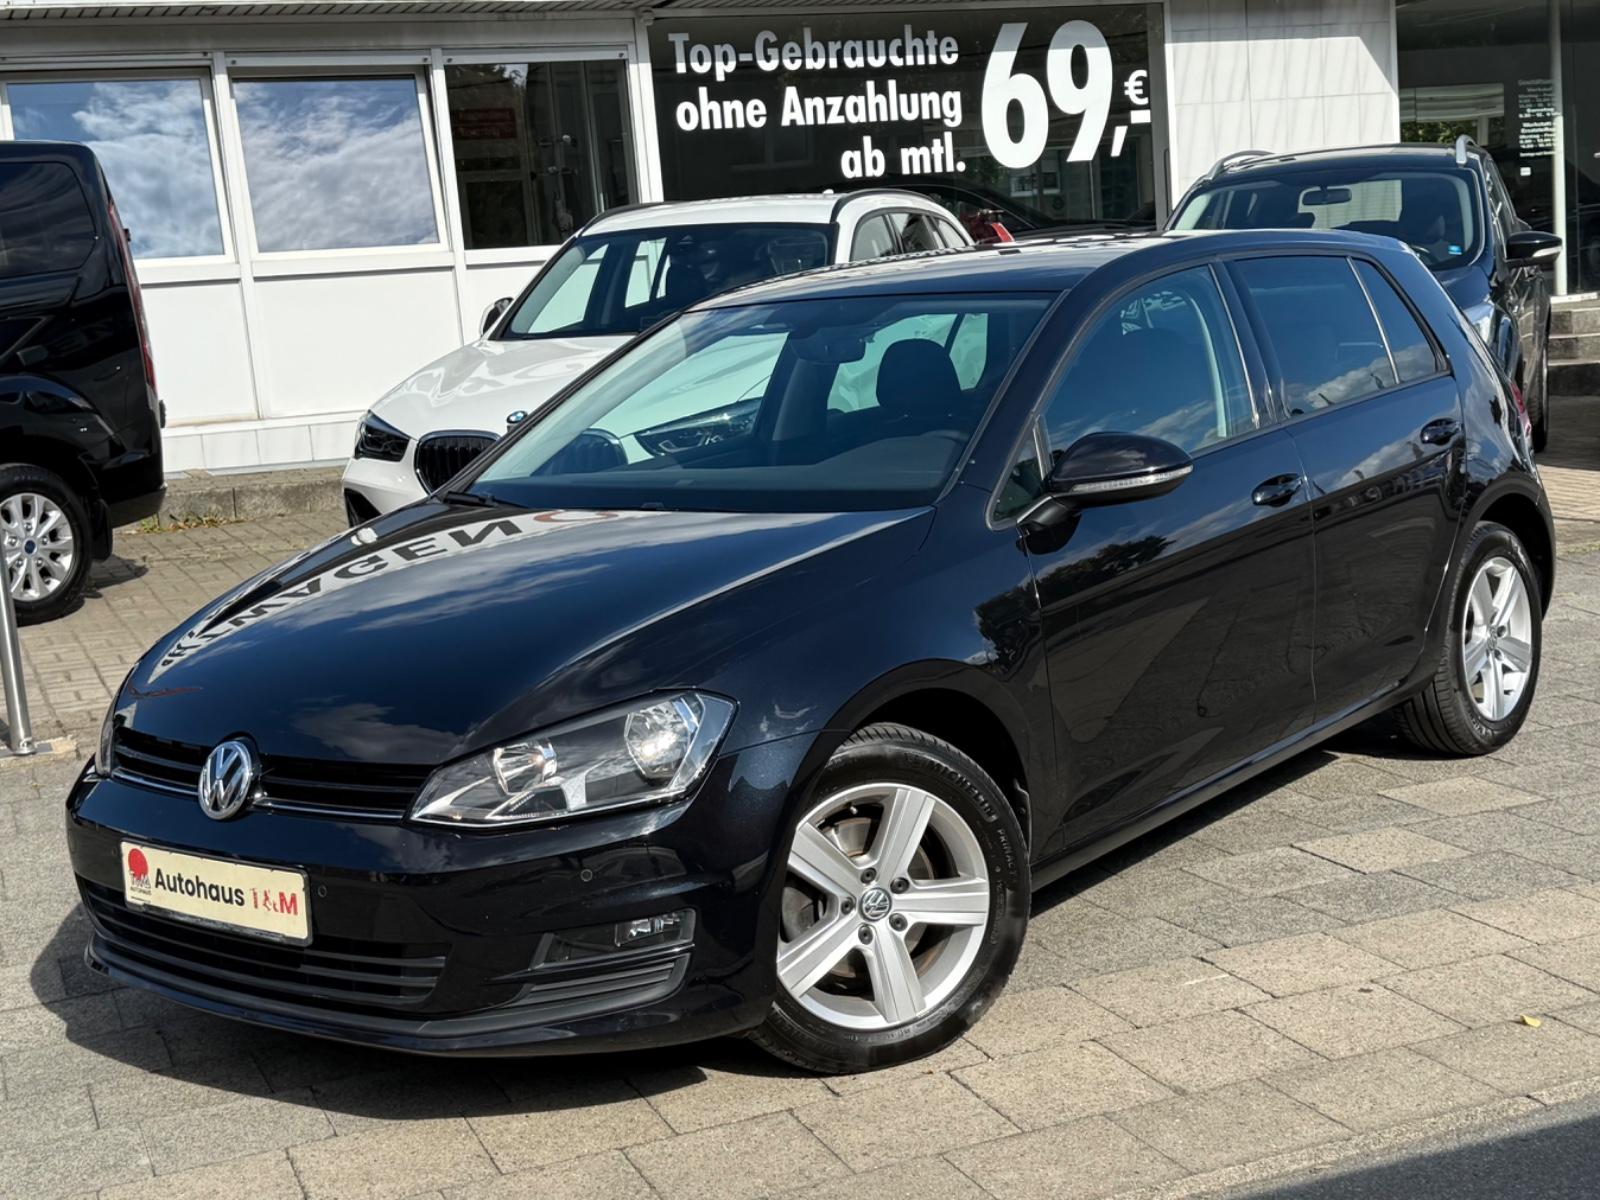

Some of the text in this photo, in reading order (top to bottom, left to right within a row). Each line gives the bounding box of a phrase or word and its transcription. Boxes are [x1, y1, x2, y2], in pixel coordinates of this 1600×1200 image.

[668, 24, 959, 82] Top-Gebrauchte
[676, 79, 962, 131] ohne Anzahlung
[1123, 69, 1149, 105] €
[841, 131, 966, 178] ab mtl.
[155, 868, 245, 906] Autohaus
